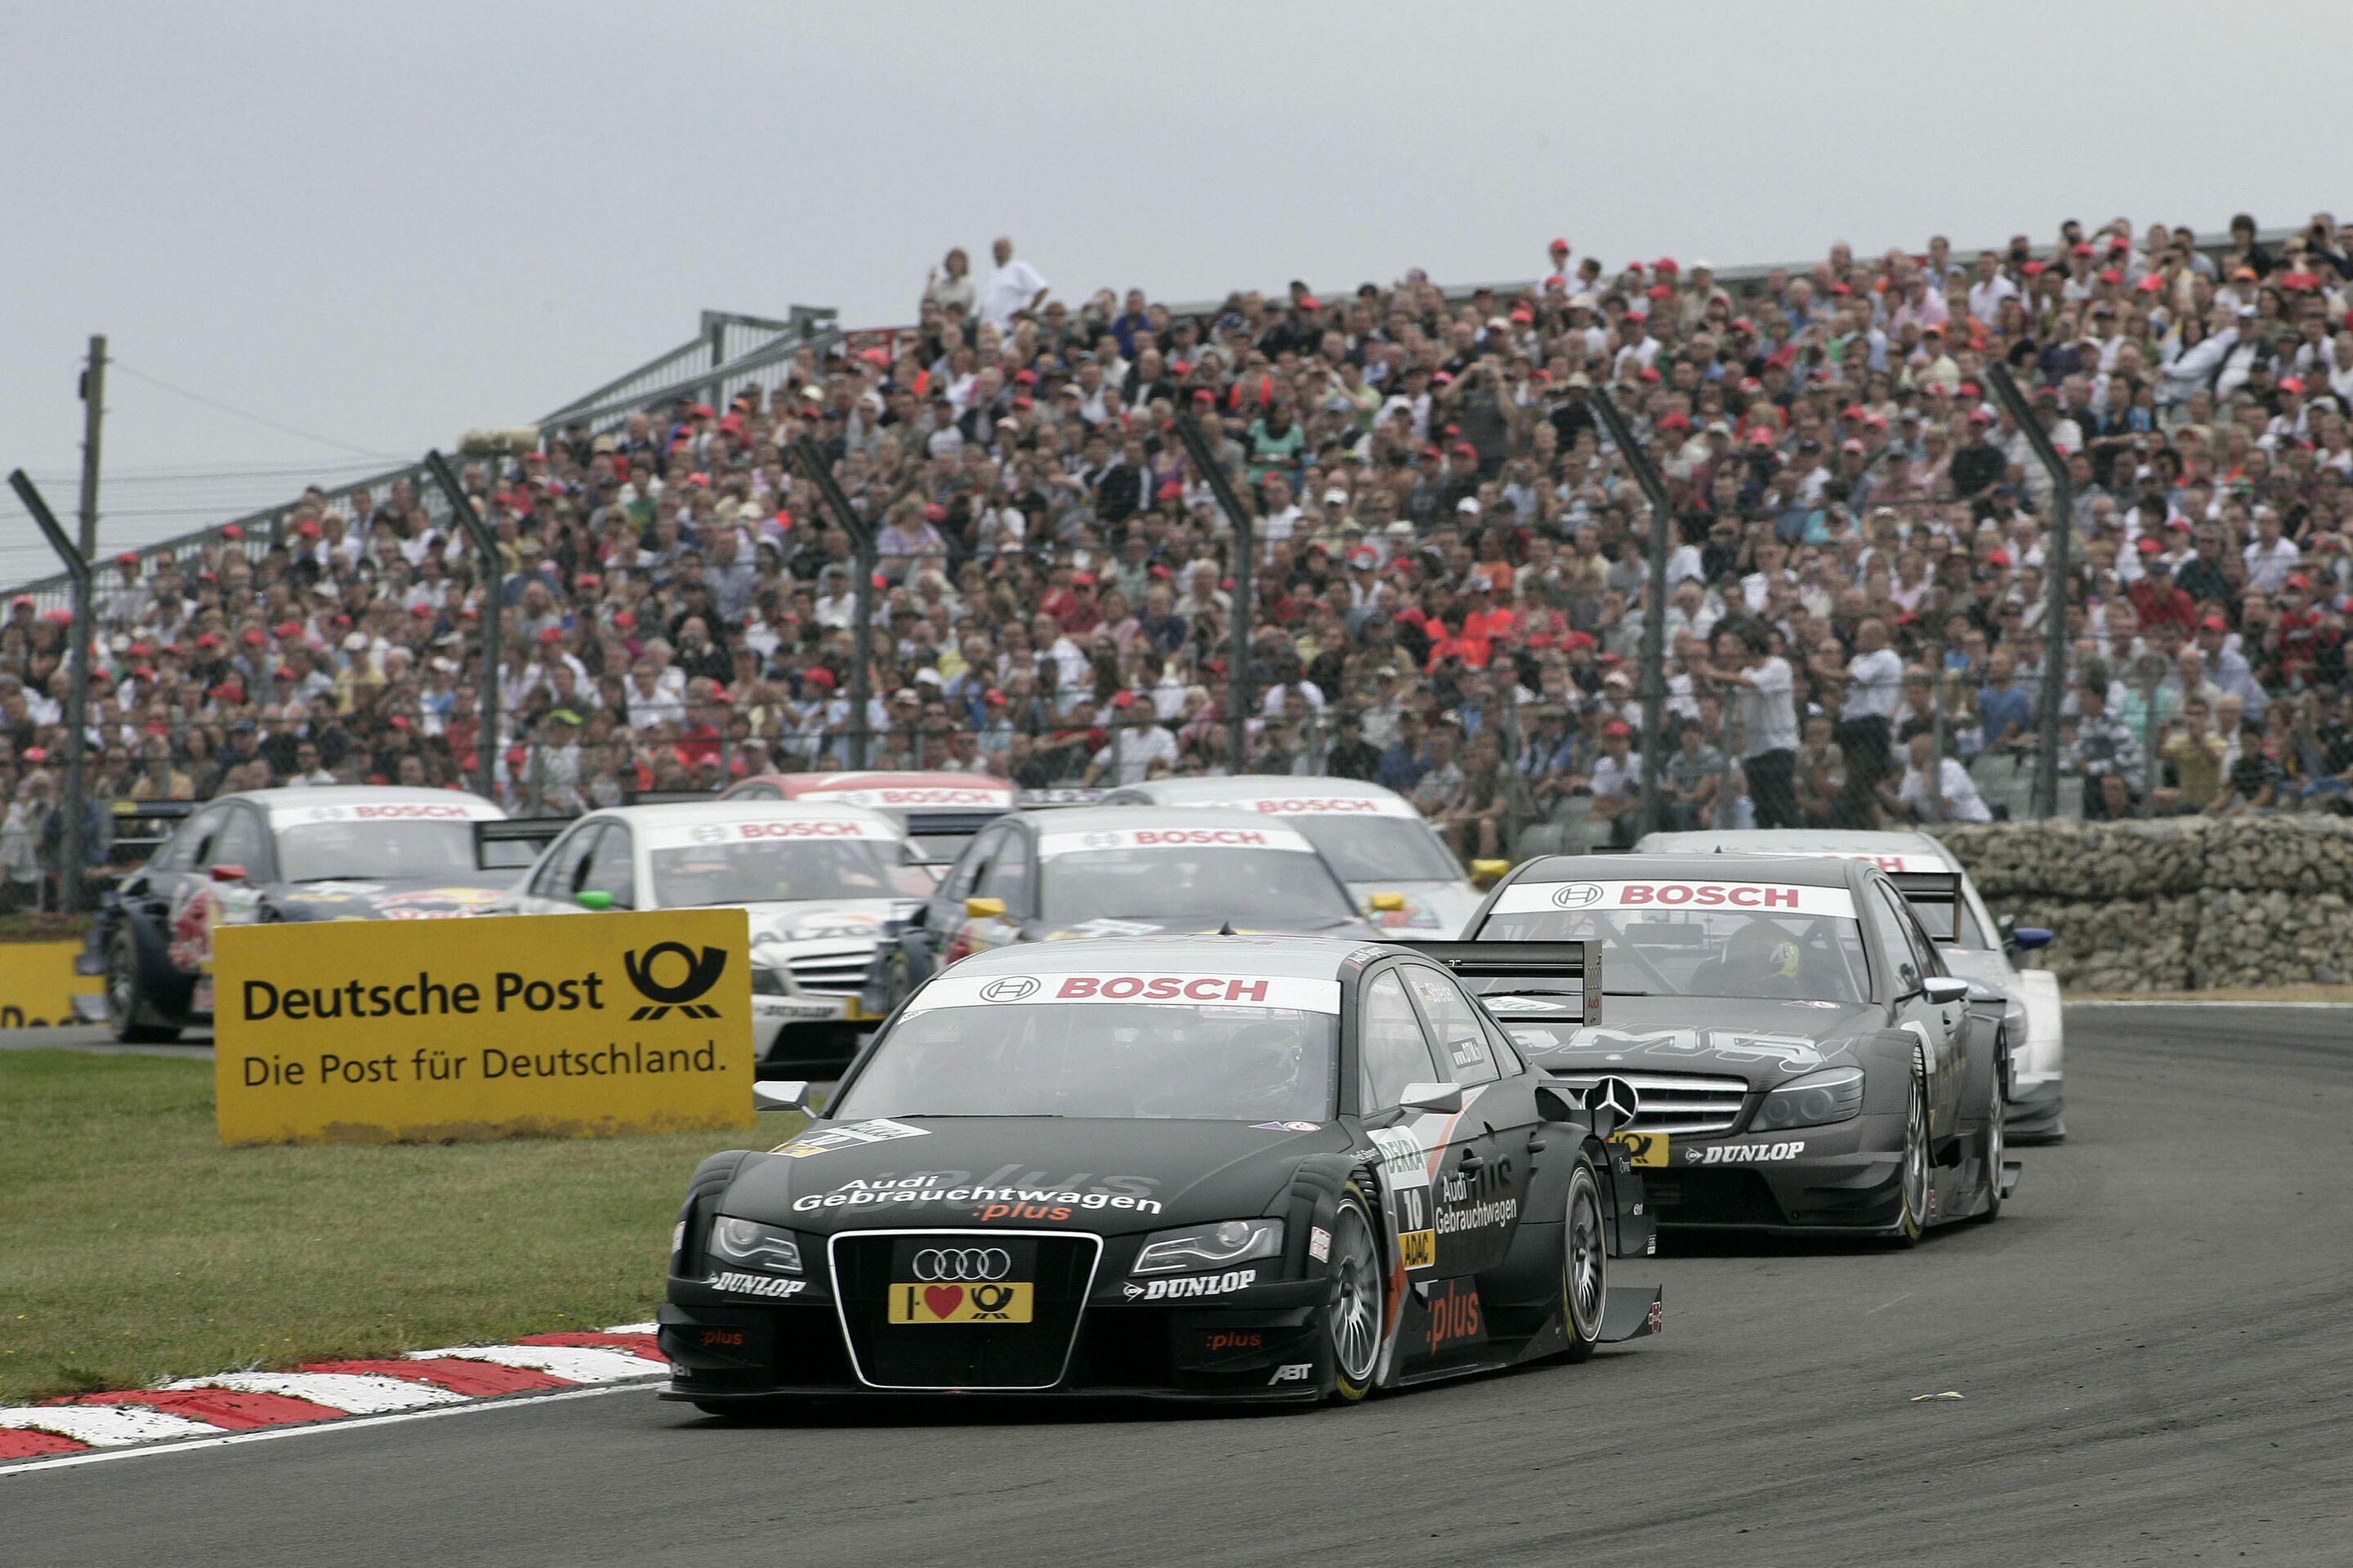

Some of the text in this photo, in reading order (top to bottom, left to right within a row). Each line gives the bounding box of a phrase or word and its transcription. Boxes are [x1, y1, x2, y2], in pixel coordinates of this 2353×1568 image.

[880, 787, 995, 805] BOSCH
[1257, 798, 1378, 814] BOSCH
[354, 805, 471, 818] BOSCH
[739, 821, 864, 839] BOSCH
[1134, 829, 1266, 847] BOSCH
[1619, 884, 1799, 909] BOSCH
[243, 972, 605, 1021] Deutsche Post
[1056, 976, 1270, 1002] BOSCH
[245, 1039, 727, 1087] Die Post für Deutschland.
[1381, 1137, 1426, 1174] DEKRA
[1702, 1141, 1805, 1164] DUNLOP
[836, 1174, 939, 1193] Audi
[1443, 1172, 1467, 1204] Audi
[791, 1185, 1163, 1215] Gebrauchtwagen
[972, 1201, 1074, 1222] :plus
[1403, 1188, 1423, 1231] 10
[1435, 1197, 1517, 1235] Gebrauchtwagen
[1404, 1232, 1429, 1266] ADAC
[712, 1271, 807, 1298] DUNLOP
[1144, 1269, 1257, 1300] DUNLOP
[1425, 1279, 1480, 1356] :plus
[1205, 1331, 1262, 1350] :plus
[1267, 1363, 1314, 1386] ABT
